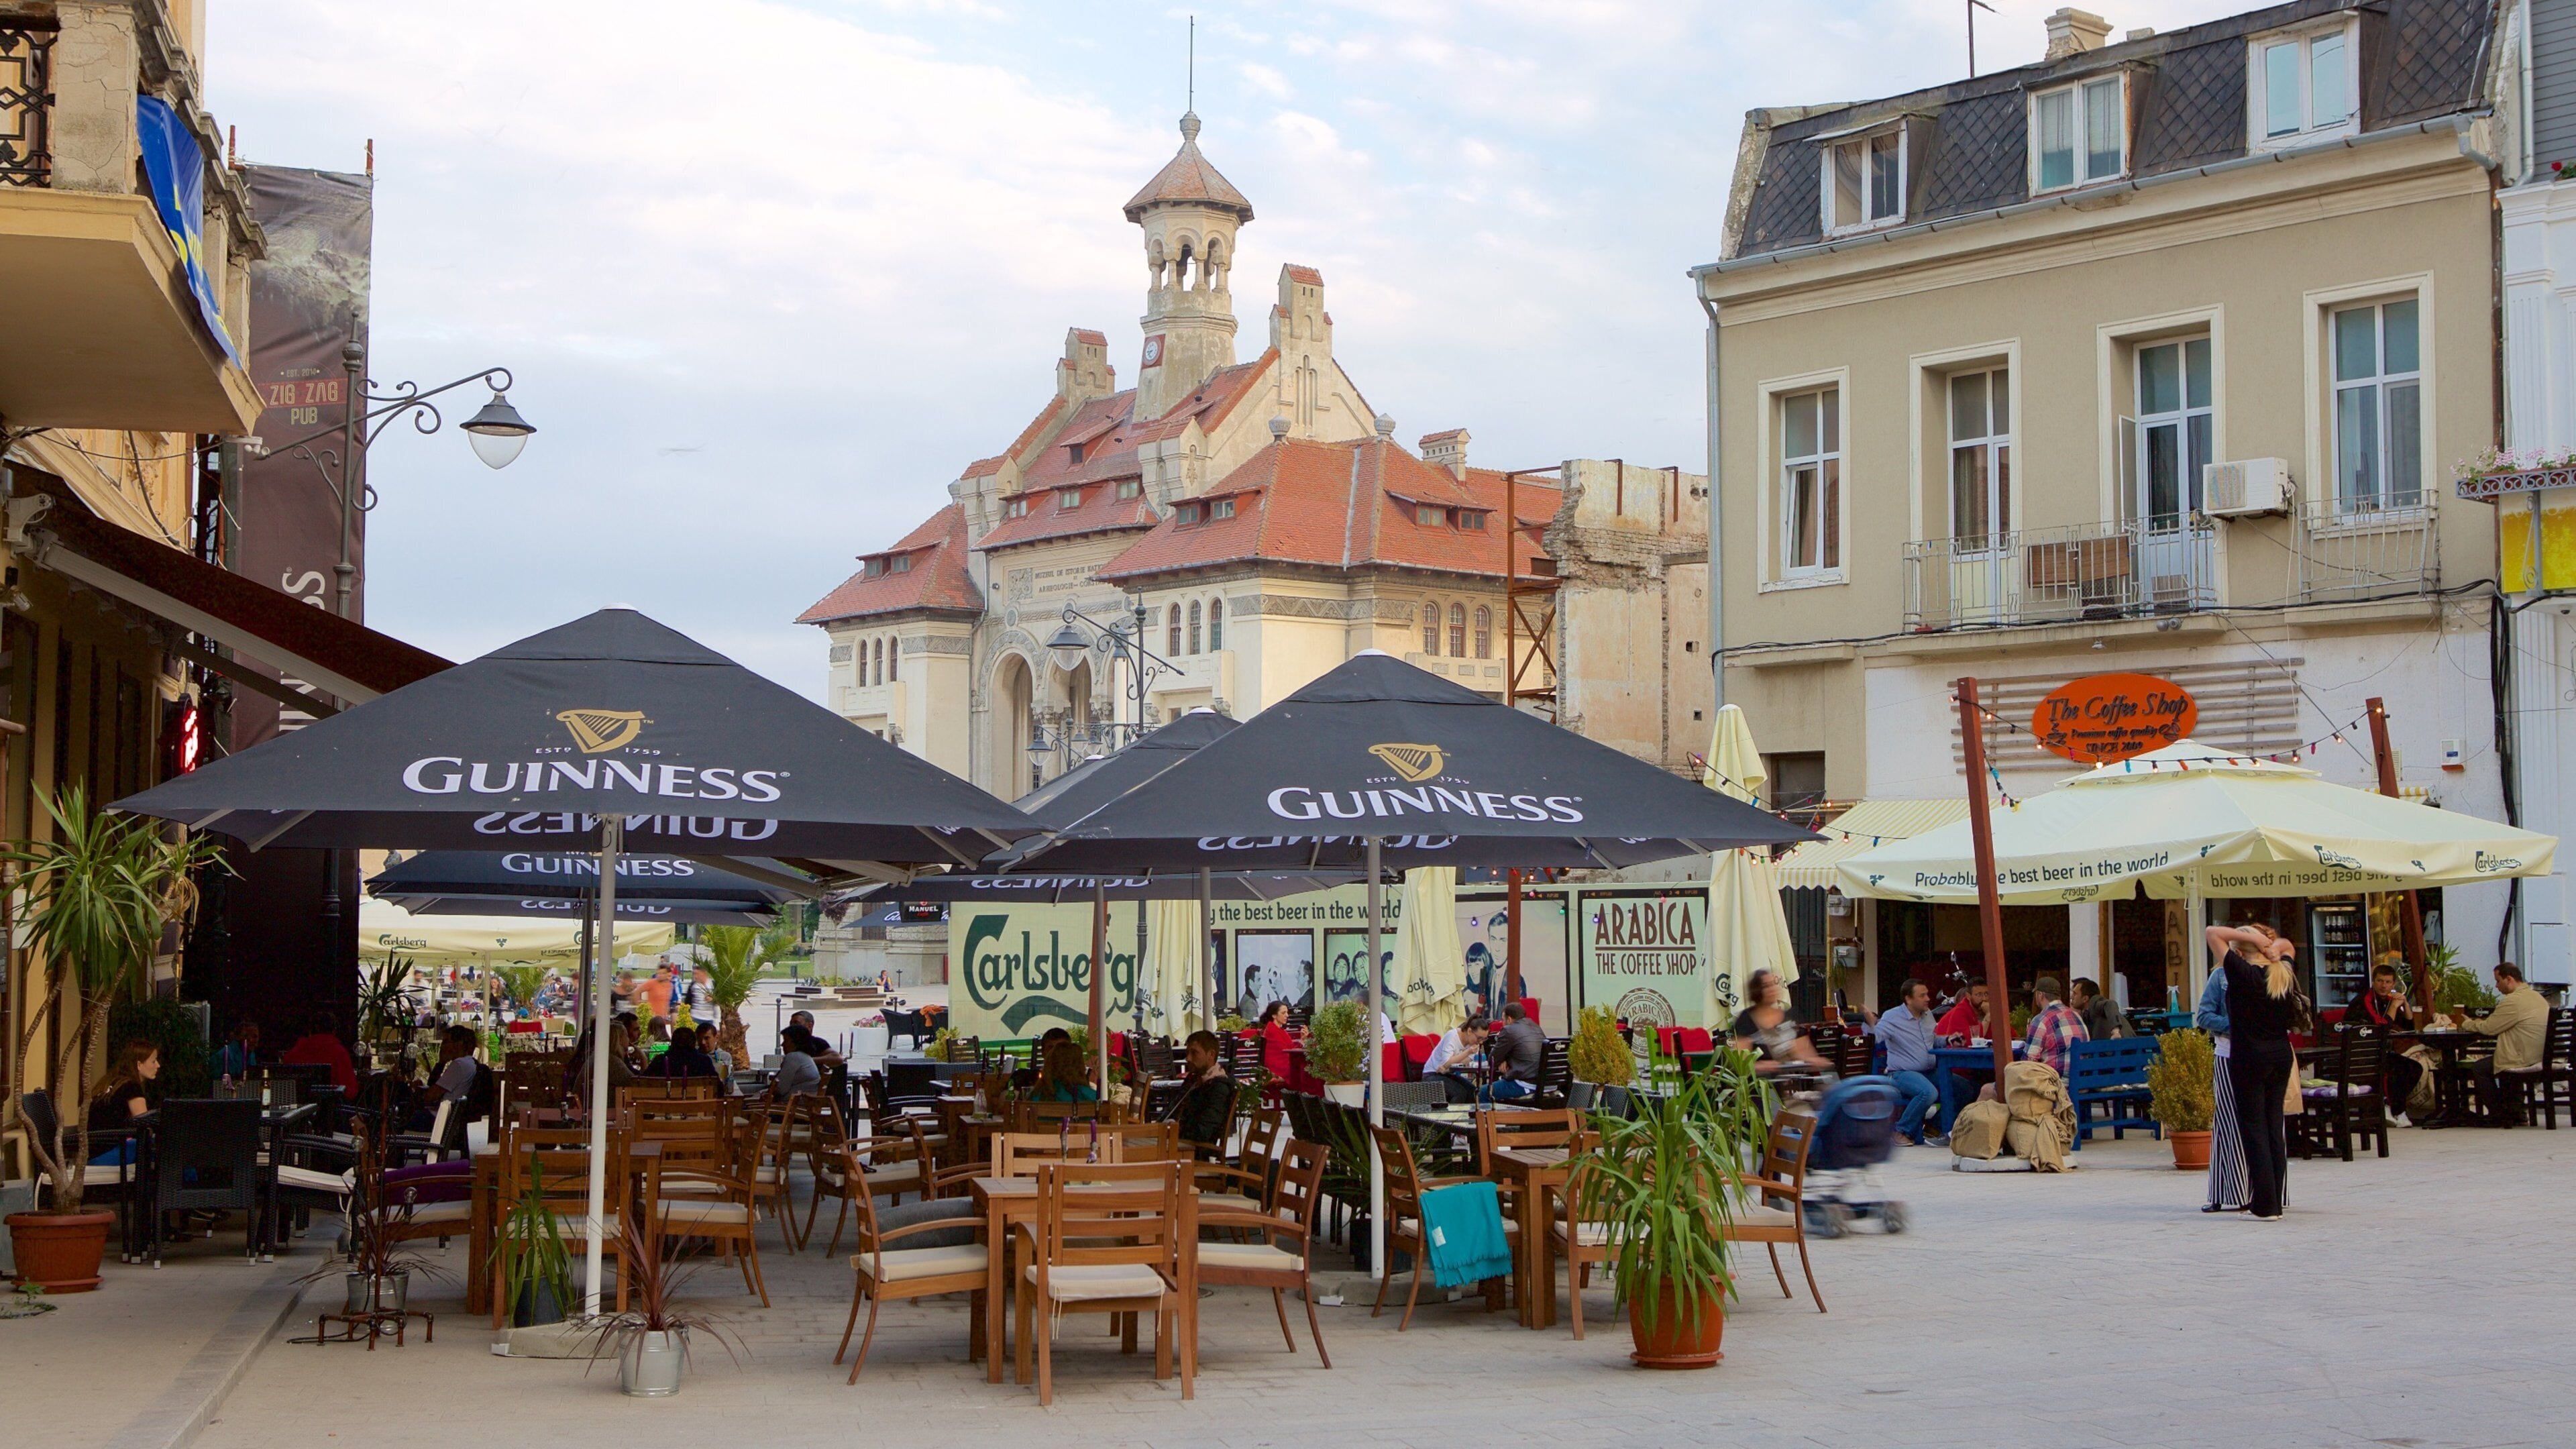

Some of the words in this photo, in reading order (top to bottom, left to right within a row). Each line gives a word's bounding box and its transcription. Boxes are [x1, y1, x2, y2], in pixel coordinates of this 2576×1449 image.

[270, 384, 295, 405] ZIG
[305, 381, 338, 402] ZAG
[291, 407, 318, 425] PUB
[1065, 567, 1085, 576] ISTORIE
[2047, 698, 2080, 721] The
[2084, 696, 2138, 725] Coffee
[2142, 692, 2188, 722] Shop
[2130, 724, 2158, 739] quality
[2086, 742, 2118, 753] SINCE
[402, 756, 782, 802] GUINNESS
[1267, 786, 1585, 823] GUINNESS
[1915, 871, 1978, 888] Probably
[2010, 869, 2039, 883] best
[2042, 865, 2075, 881] beer
[2080, 861, 2092, 877] in
[2098, 859, 2122, 876] the
[2127, 851, 2168, 871] world
[1219, 902, 1240, 920] the
[1244, 902, 1273, 920] best
[1277, 901, 1307, 920] beer
[1312, 902, 1326, 919] in
[1330, 900, 1353, 919] the
[1358, 899, 1401, 918] wrld
[1595, 902, 1695, 945] ARABICA
[379, 934, 427, 948] Carlsberg
[963, 914, 1136, 1013] Carlsbeg
[1595, 953, 1617, 975] THE
[1621, 953, 1662, 975] COFFEE
[1666, 953, 1697, 975] SHOP
